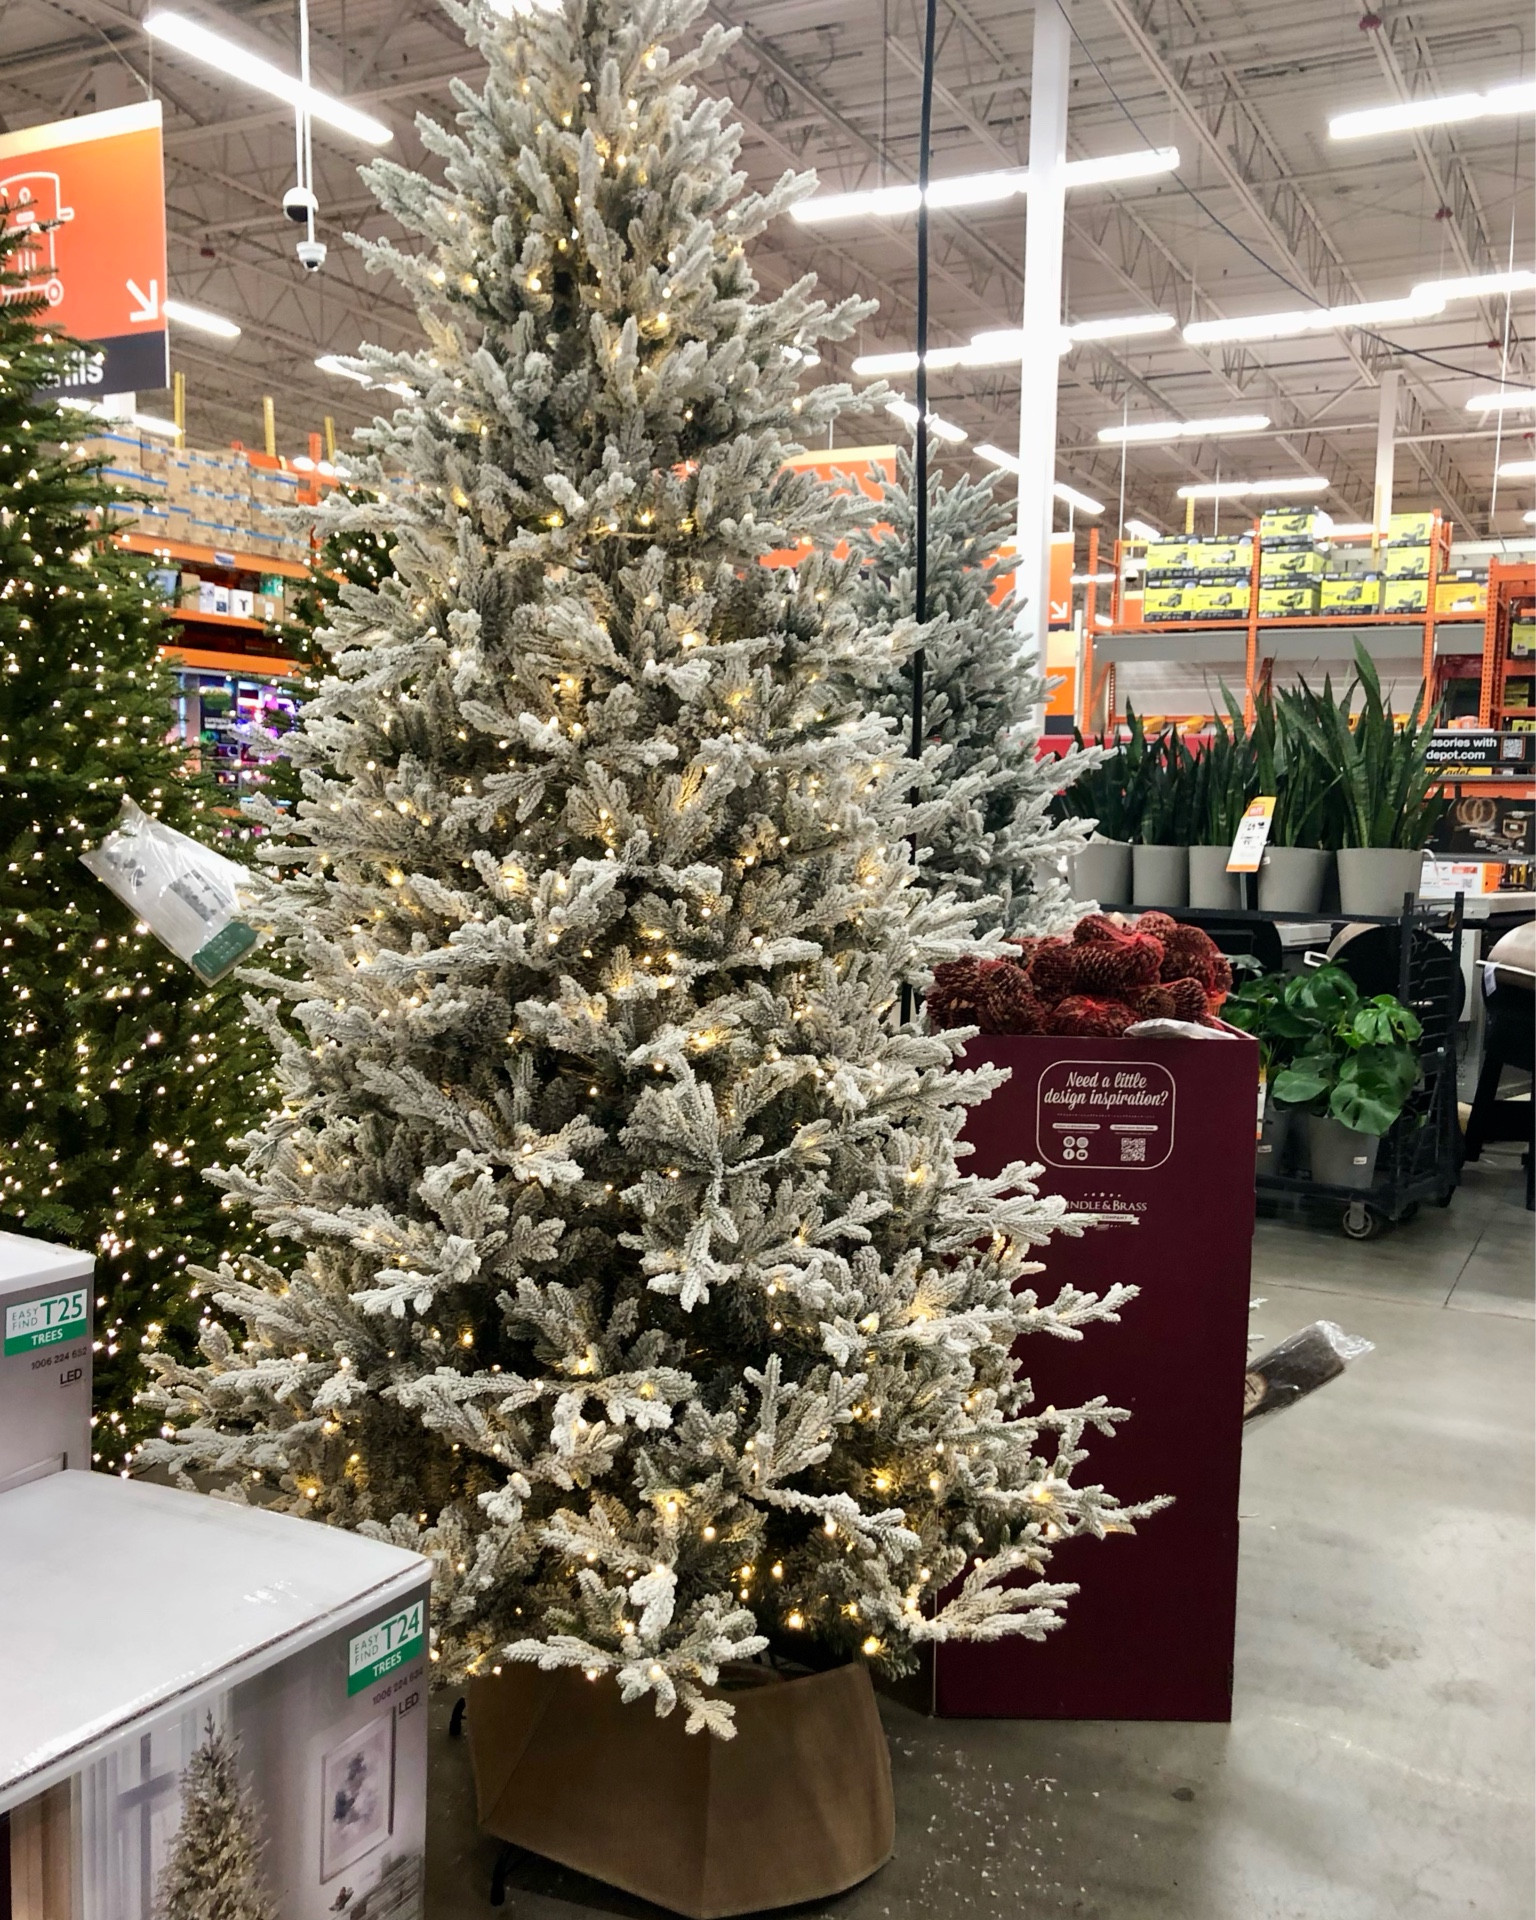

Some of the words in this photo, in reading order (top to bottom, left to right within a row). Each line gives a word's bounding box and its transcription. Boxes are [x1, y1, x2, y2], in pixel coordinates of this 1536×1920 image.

[1473, 737, 1497, 747] with
[1426, 750, 1485, 761] depot.com
[1066, 1072, 1099, 1087] Need
[1101, 1077, 1110, 1087] a
[1115, 1072, 1147, 1088] little
[1044, 1089, 1085, 1110] design
[1090, 1090, 1168, 1109] inspiration?
[1066, 1200, 1100, 1211] INDLE
[1102, 1201, 1111, 1211] &
[13, 1307, 38, 1321] EASY
[40, 1294, 82, 1325] T25
[13, 1317, 38, 1331] FIND
[31, 1328, 63, 1346] TREES
[60, 1368, 83, 1385] LED
[354, 1632, 379, 1655] EASY
[381, 1606, 419, 1650] T24
[354, 1645, 379, 1665] FIND
[372, 1651, 402, 1677] TREES
[398, 1692, 419, 1714] LED
